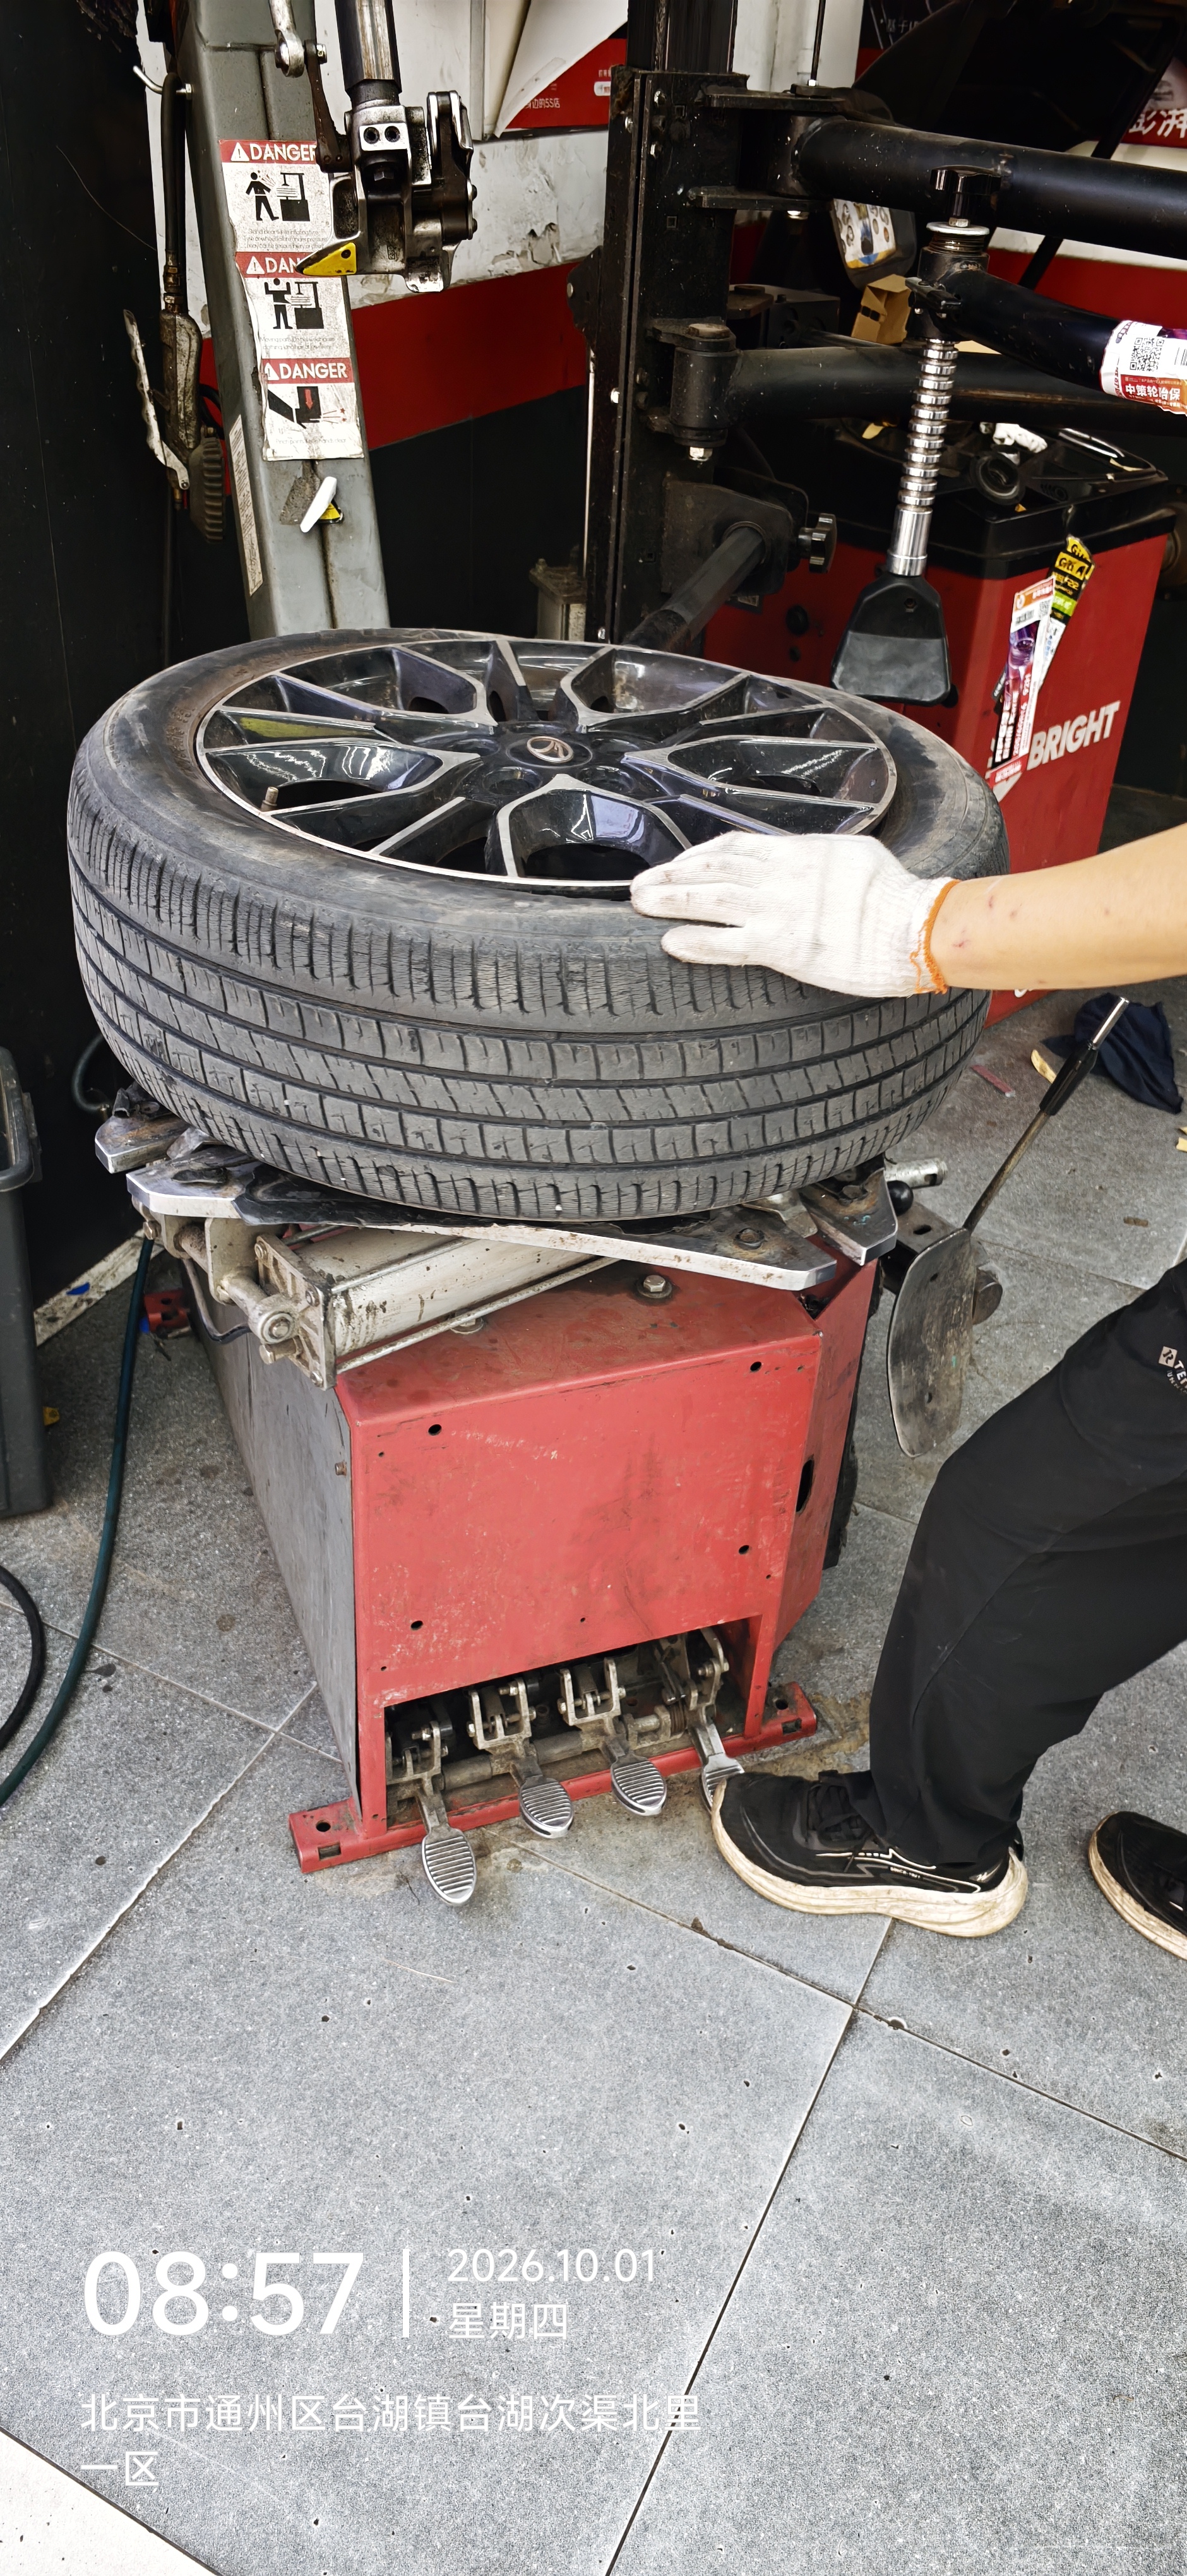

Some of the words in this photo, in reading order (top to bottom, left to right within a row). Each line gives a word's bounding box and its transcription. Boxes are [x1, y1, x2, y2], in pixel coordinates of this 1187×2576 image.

[250, 143, 317, 161] DANGER
[265, 258, 301, 273] DAN
[279, 362, 348, 379] DANGER
[1027, 700, 1121, 770] BRIGHT
